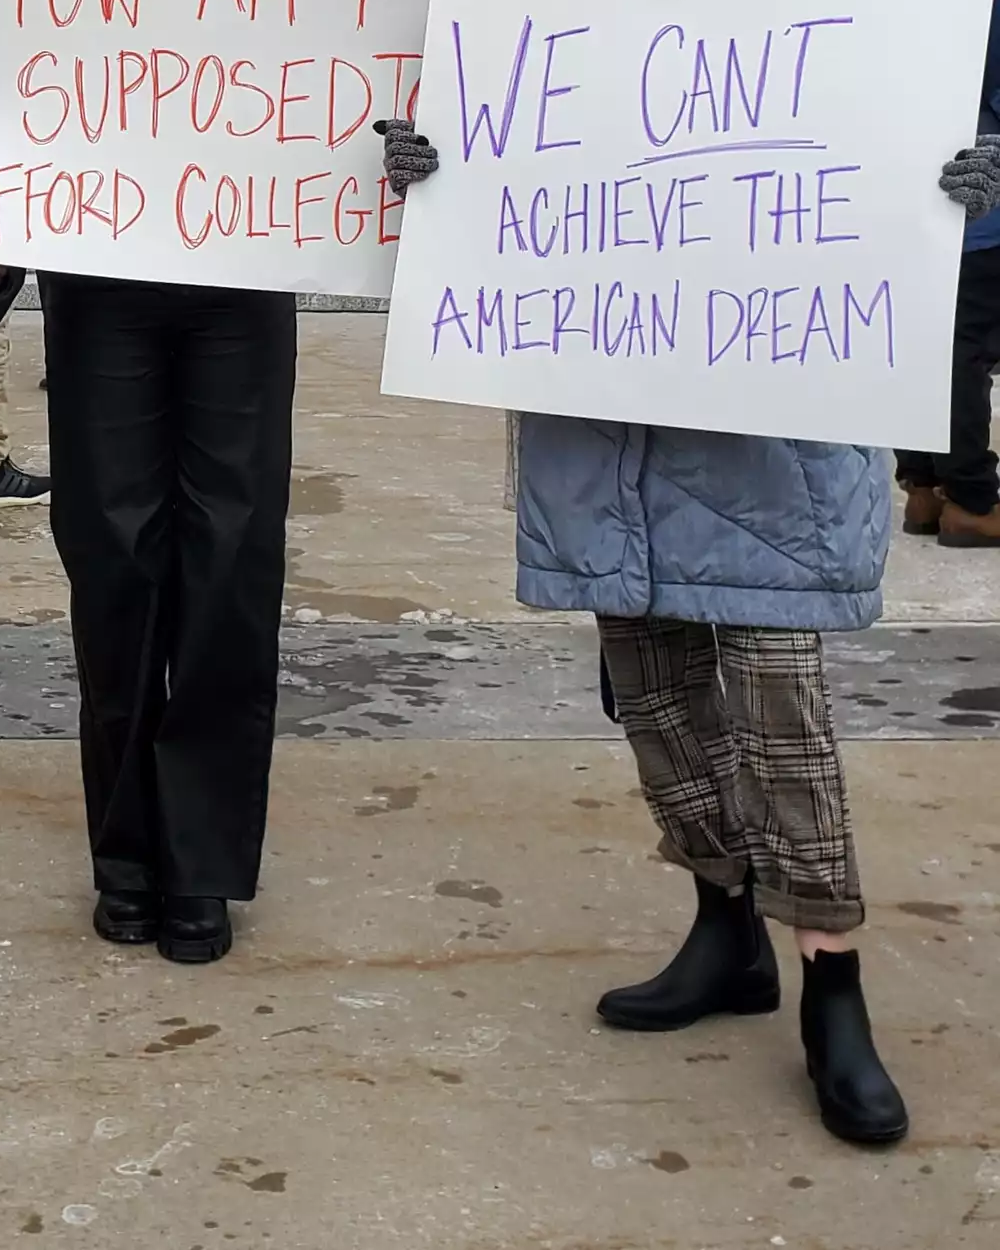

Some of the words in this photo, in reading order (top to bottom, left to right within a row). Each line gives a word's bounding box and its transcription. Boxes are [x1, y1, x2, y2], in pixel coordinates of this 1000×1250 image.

[24, 50, 371, 147] SUPPOSED
[451, 17, 589, 160] WE
[497, 175, 711, 258] ACHIEVE
[735, 166, 860, 250] THE
[431, 280, 680, 359] AMERICAN
[707, 280, 893, 367] DREAM
